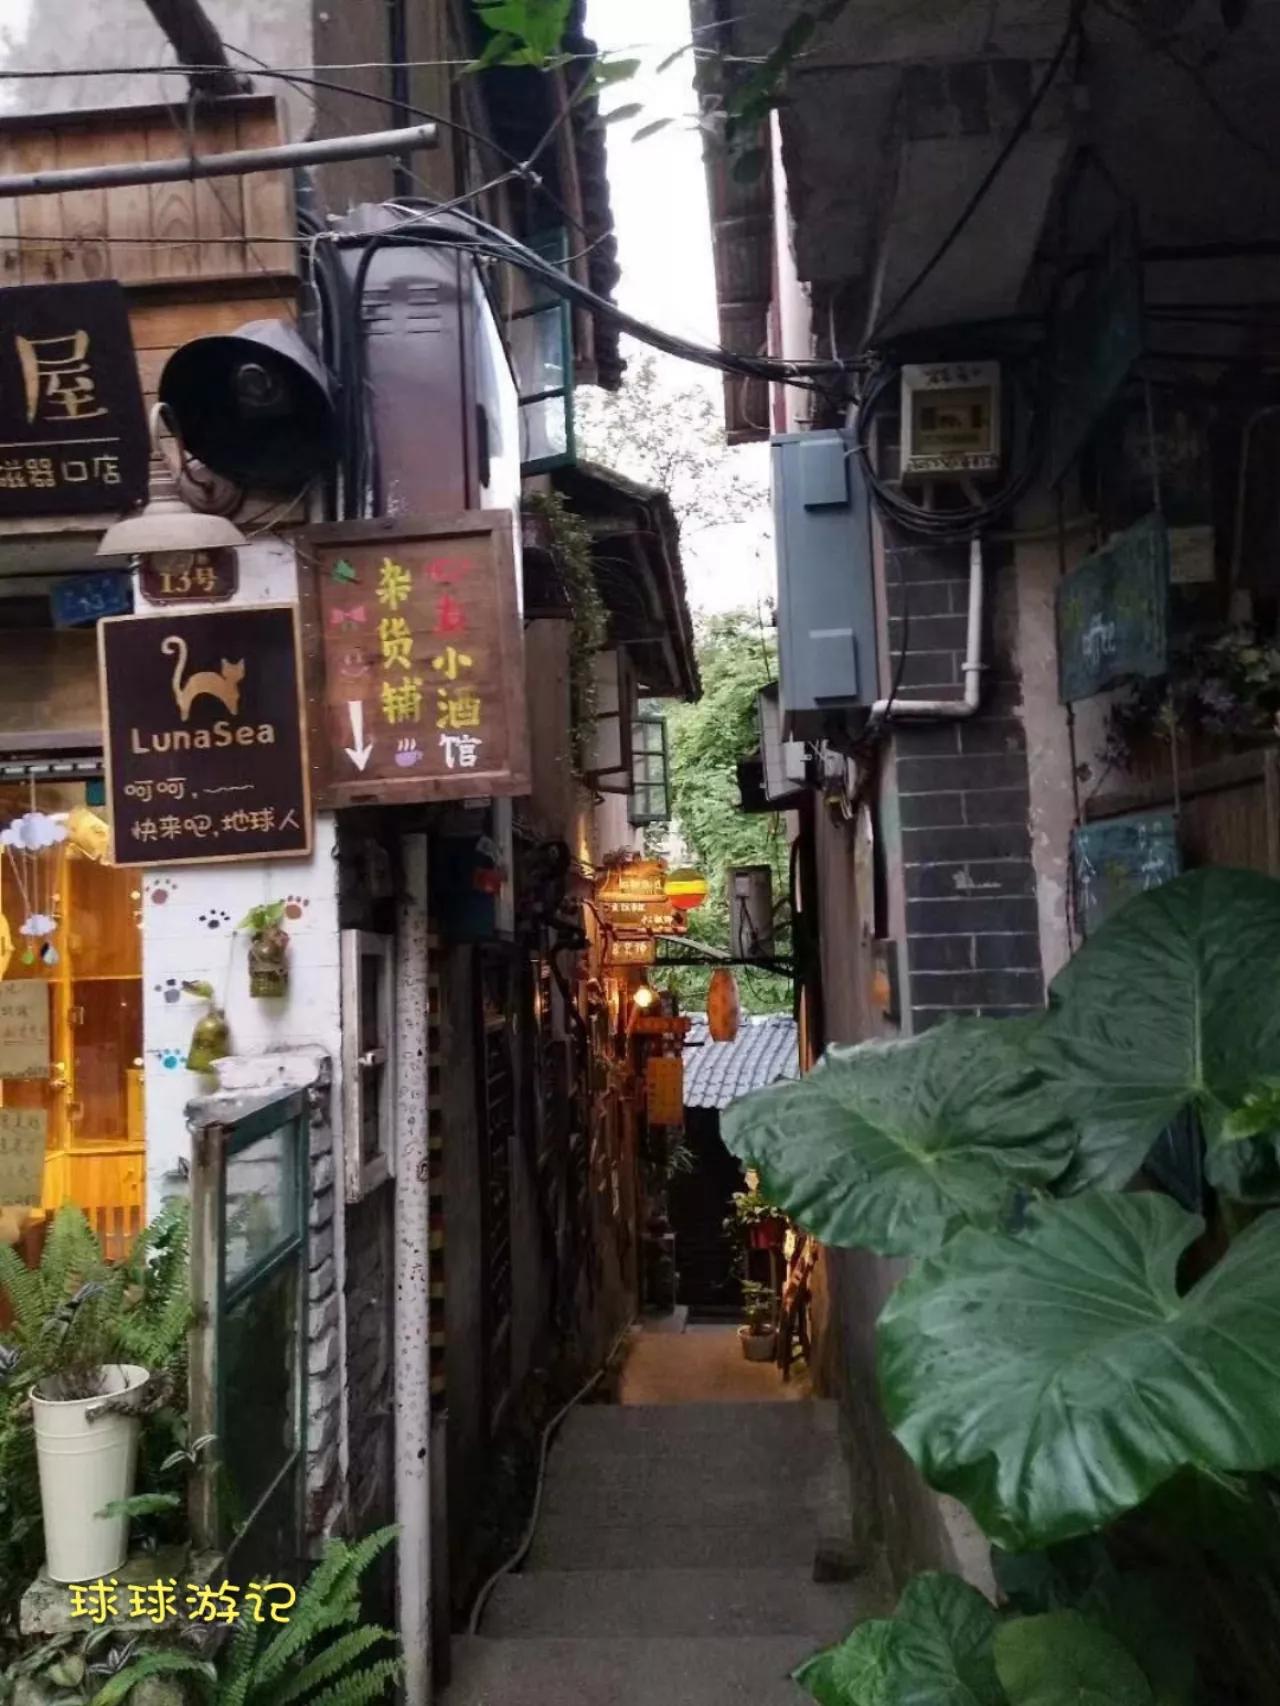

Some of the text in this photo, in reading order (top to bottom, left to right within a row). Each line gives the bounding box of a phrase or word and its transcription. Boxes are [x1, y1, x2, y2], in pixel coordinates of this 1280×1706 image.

[15, 329, 108, 424] 屋
[159, 567, 219, 594] 13号
[376, 557, 422, 724] 杂货铺
[131, 720, 275, 754] LunaSea
[432, 646, 482, 768] 小酒馆
